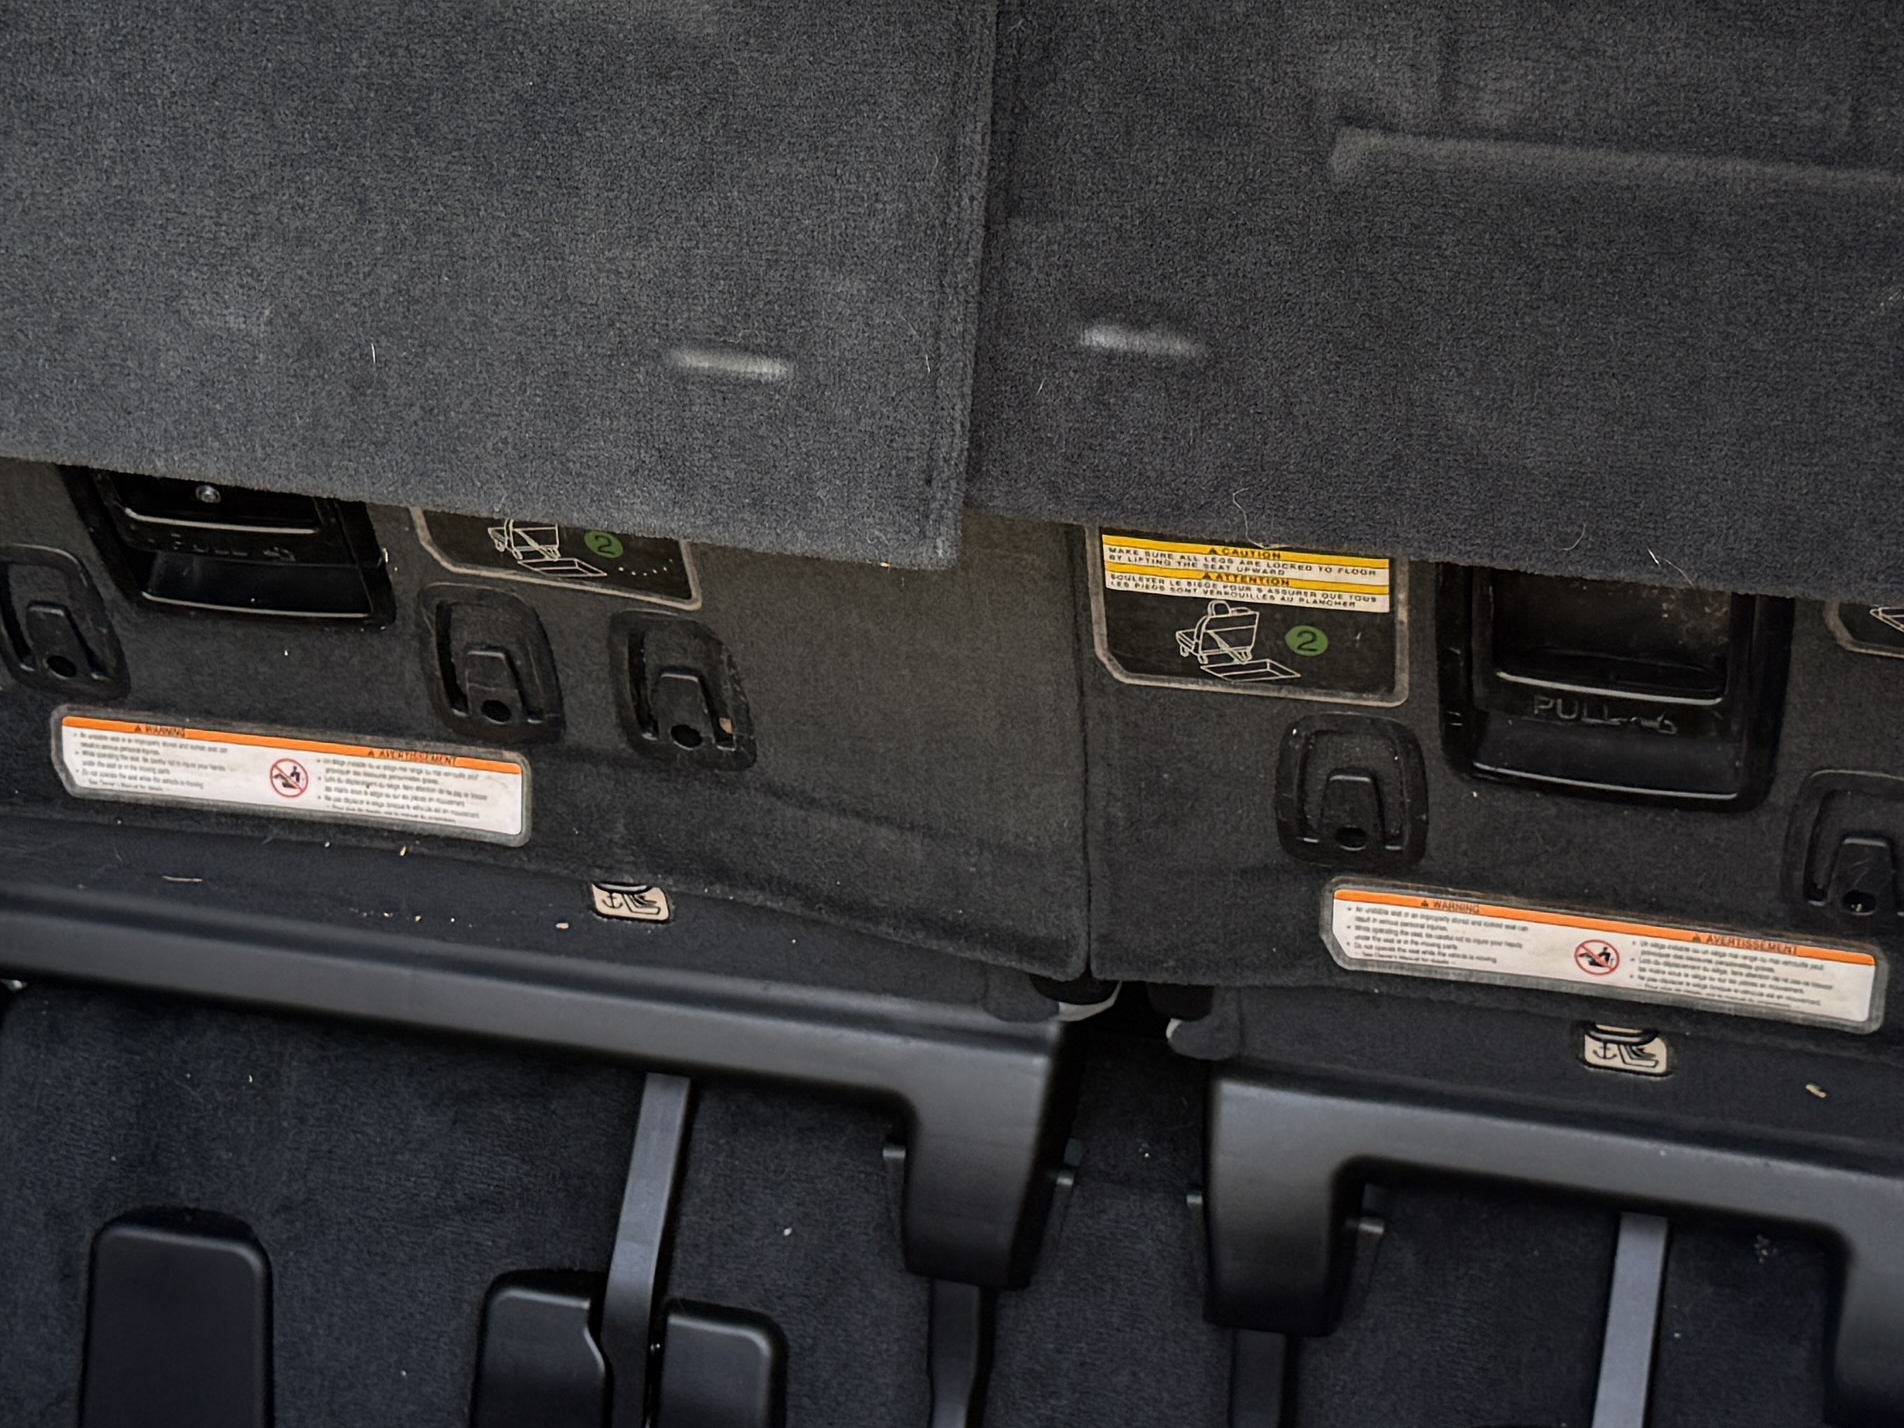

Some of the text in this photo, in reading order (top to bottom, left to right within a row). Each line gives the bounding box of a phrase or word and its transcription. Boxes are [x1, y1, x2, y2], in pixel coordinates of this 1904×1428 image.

[594, 534, 617, 556] 2
[1221, 547, 1281, 560] CAUTION
[1108, 546, 1139, 556] MAKE
[1180, 554, 1200, 562] ALL
[1240, 559, 1261, 567] ARE
[1266, 562, 1312, 572] LOCKED
[1338, 567, 1377, 576] FLOOR
[1108, 554, 1122, 562] BY
[1127, 556, 1172, 567] LIFTING
[1203, 563, 1231, 571] SEAT
[1237, 566, 1286, 576] UPWARD
[1215, 573, 1290, 586] ATTENTION
[1296, 629, 1318, 652] 2
[1534, 694, 1621, 726] PULL
[1434, 900, 1480, 914] WARNING
[1707, 934, 1797, 956] AVERTISSEMENT
